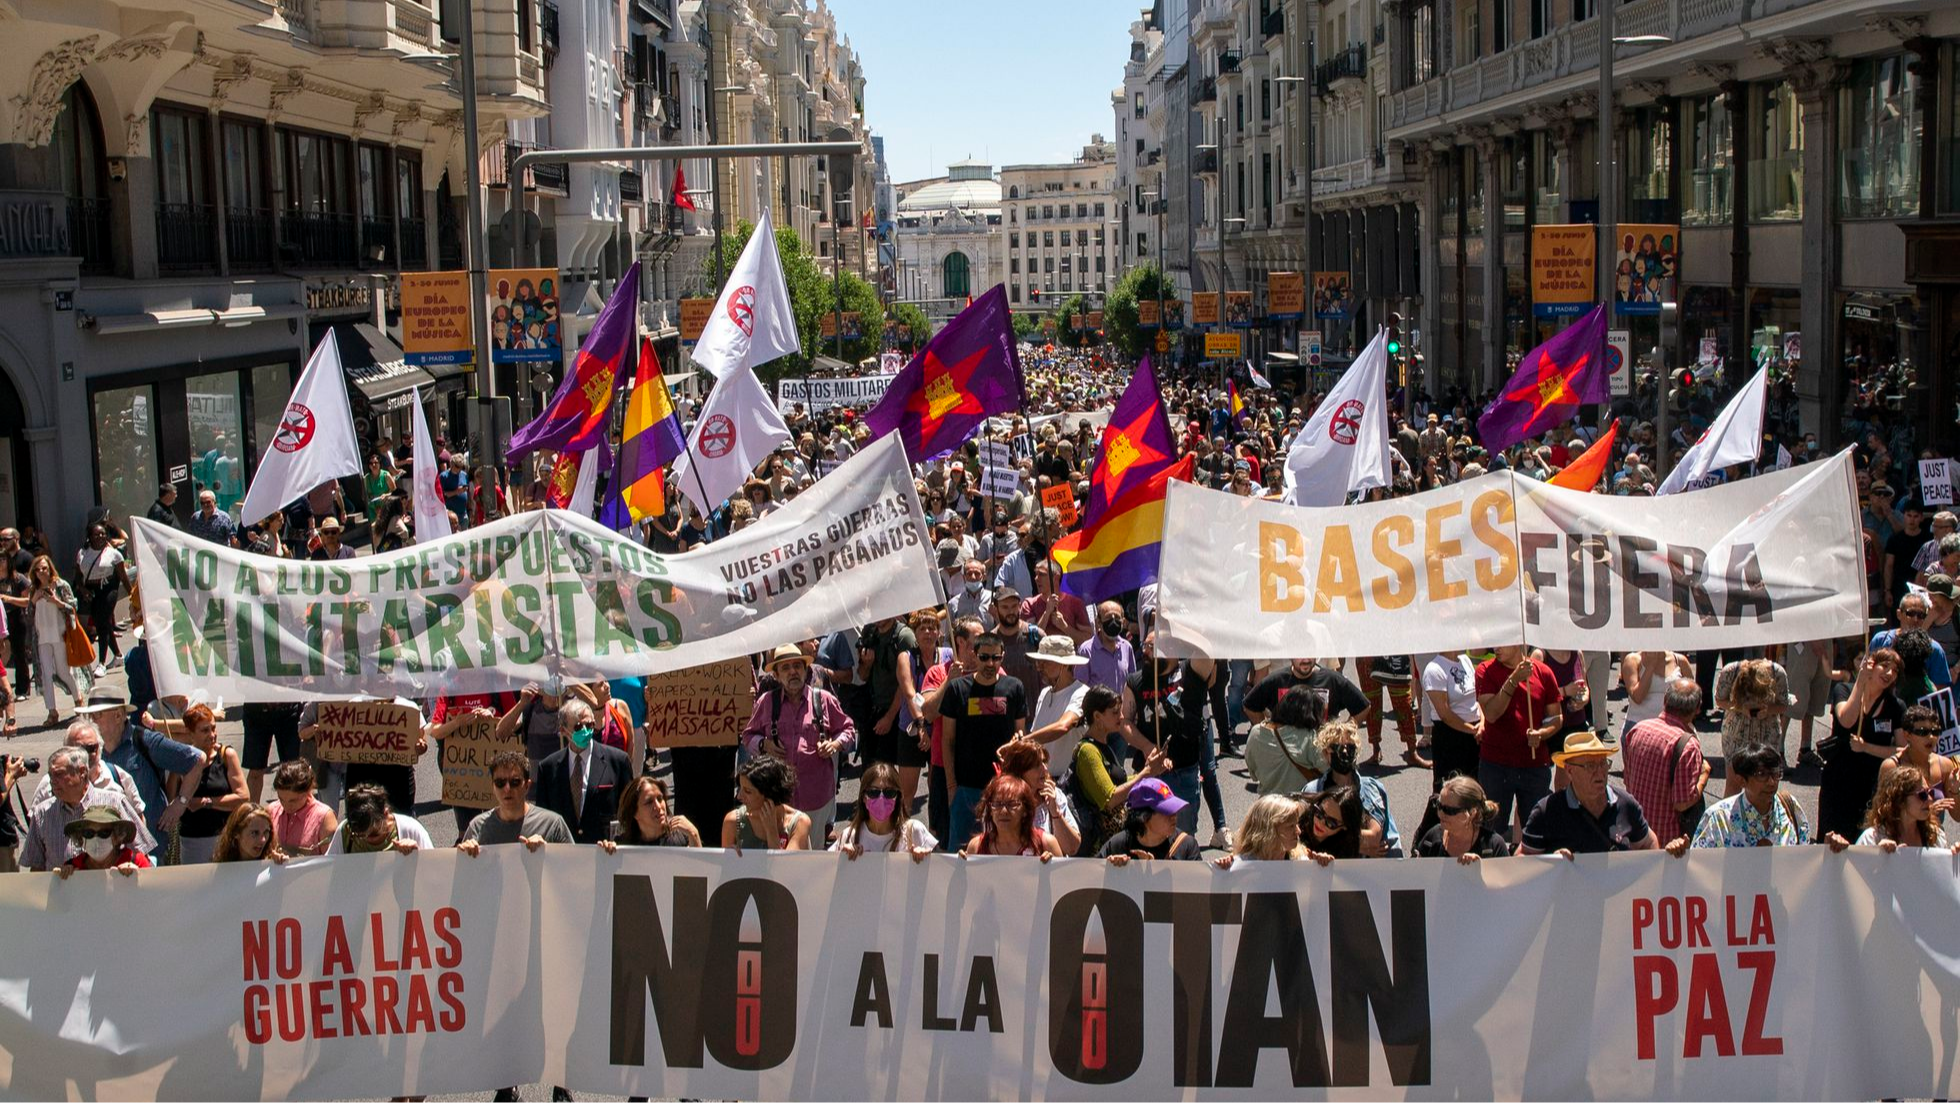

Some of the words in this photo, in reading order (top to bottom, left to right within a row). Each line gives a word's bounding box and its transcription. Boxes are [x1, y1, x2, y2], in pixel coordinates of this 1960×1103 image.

[1552, 245, 1575, 257] DÍA
[1534, 258, 1592, 268] EUROPEO
[1546, 270, 1564, 279] DE
[1565, 270, 1582, 279] LA
[1539, 279, 1587, 290] MÚSICA
[423, 293, 448, 305] DÍA
[404, 305, 467, 317] EUROPEO
[1554, 305, 1580, 313] MADRID
[417, 318, 434, 328] DE
[438, 317, 455, 328] LA
[411, 327, 462, 340] MÚSICA
[428, 355, 455, 363] MADRID
[782, 382, 831, 399] GASTOS
[1924, 461, 1946, 478] JUST
[1046, 490, 1067, 503] JUST
[1923, 484, 1952, 501] PEACE!
[719, 531, 822, 583] VUESTRAS
[826, 492, 911, 543] GUERRAS
[165, 546, 219, 591] NO
[234, 560, 261, 596] A
[368, 528, 669, 595] PRESUPUESTOS
[725, 574, 758, 606] NO
[764, 559, 807, 597] LAS
[815, 520, 919, 583] PAGAMOS
[1259, 488, 1518, 615] BASES
[1520, 531, 1774, 630] FUERA
[170, 577, 684, 678] MILITARISTAS
[703, 663, 746, 680] WORK
[650, 684, 696, 698] PAPERS
[712, 683, 744, 696] ALL
[650, 697, 739, 717] #MELILLA
[650, 715, 752, 738] MASSACRE
[319, 731, 411, 751] MASSACRE
[358, 752, 418, 765] RESPONSABLE
[447, 744, 479, 767] OUR
[1632, 895, 1713, 950] POR
[1725, 893, 1776, 947] LA
[242, 917, 303, 982] NO
[322, 915, 355, 976] A
[370, 907, 463, 972] LAS
[609, 873, 799, 1072] NO
[849, 951, 895, 1029] A
[921, 953, 1004, 1034] LA
[1048, 887, 1433, 1088] OTAN
[243, 971, 467, 1045] GUERRAS
[1633, 950, 1784, 1061] PAZ
